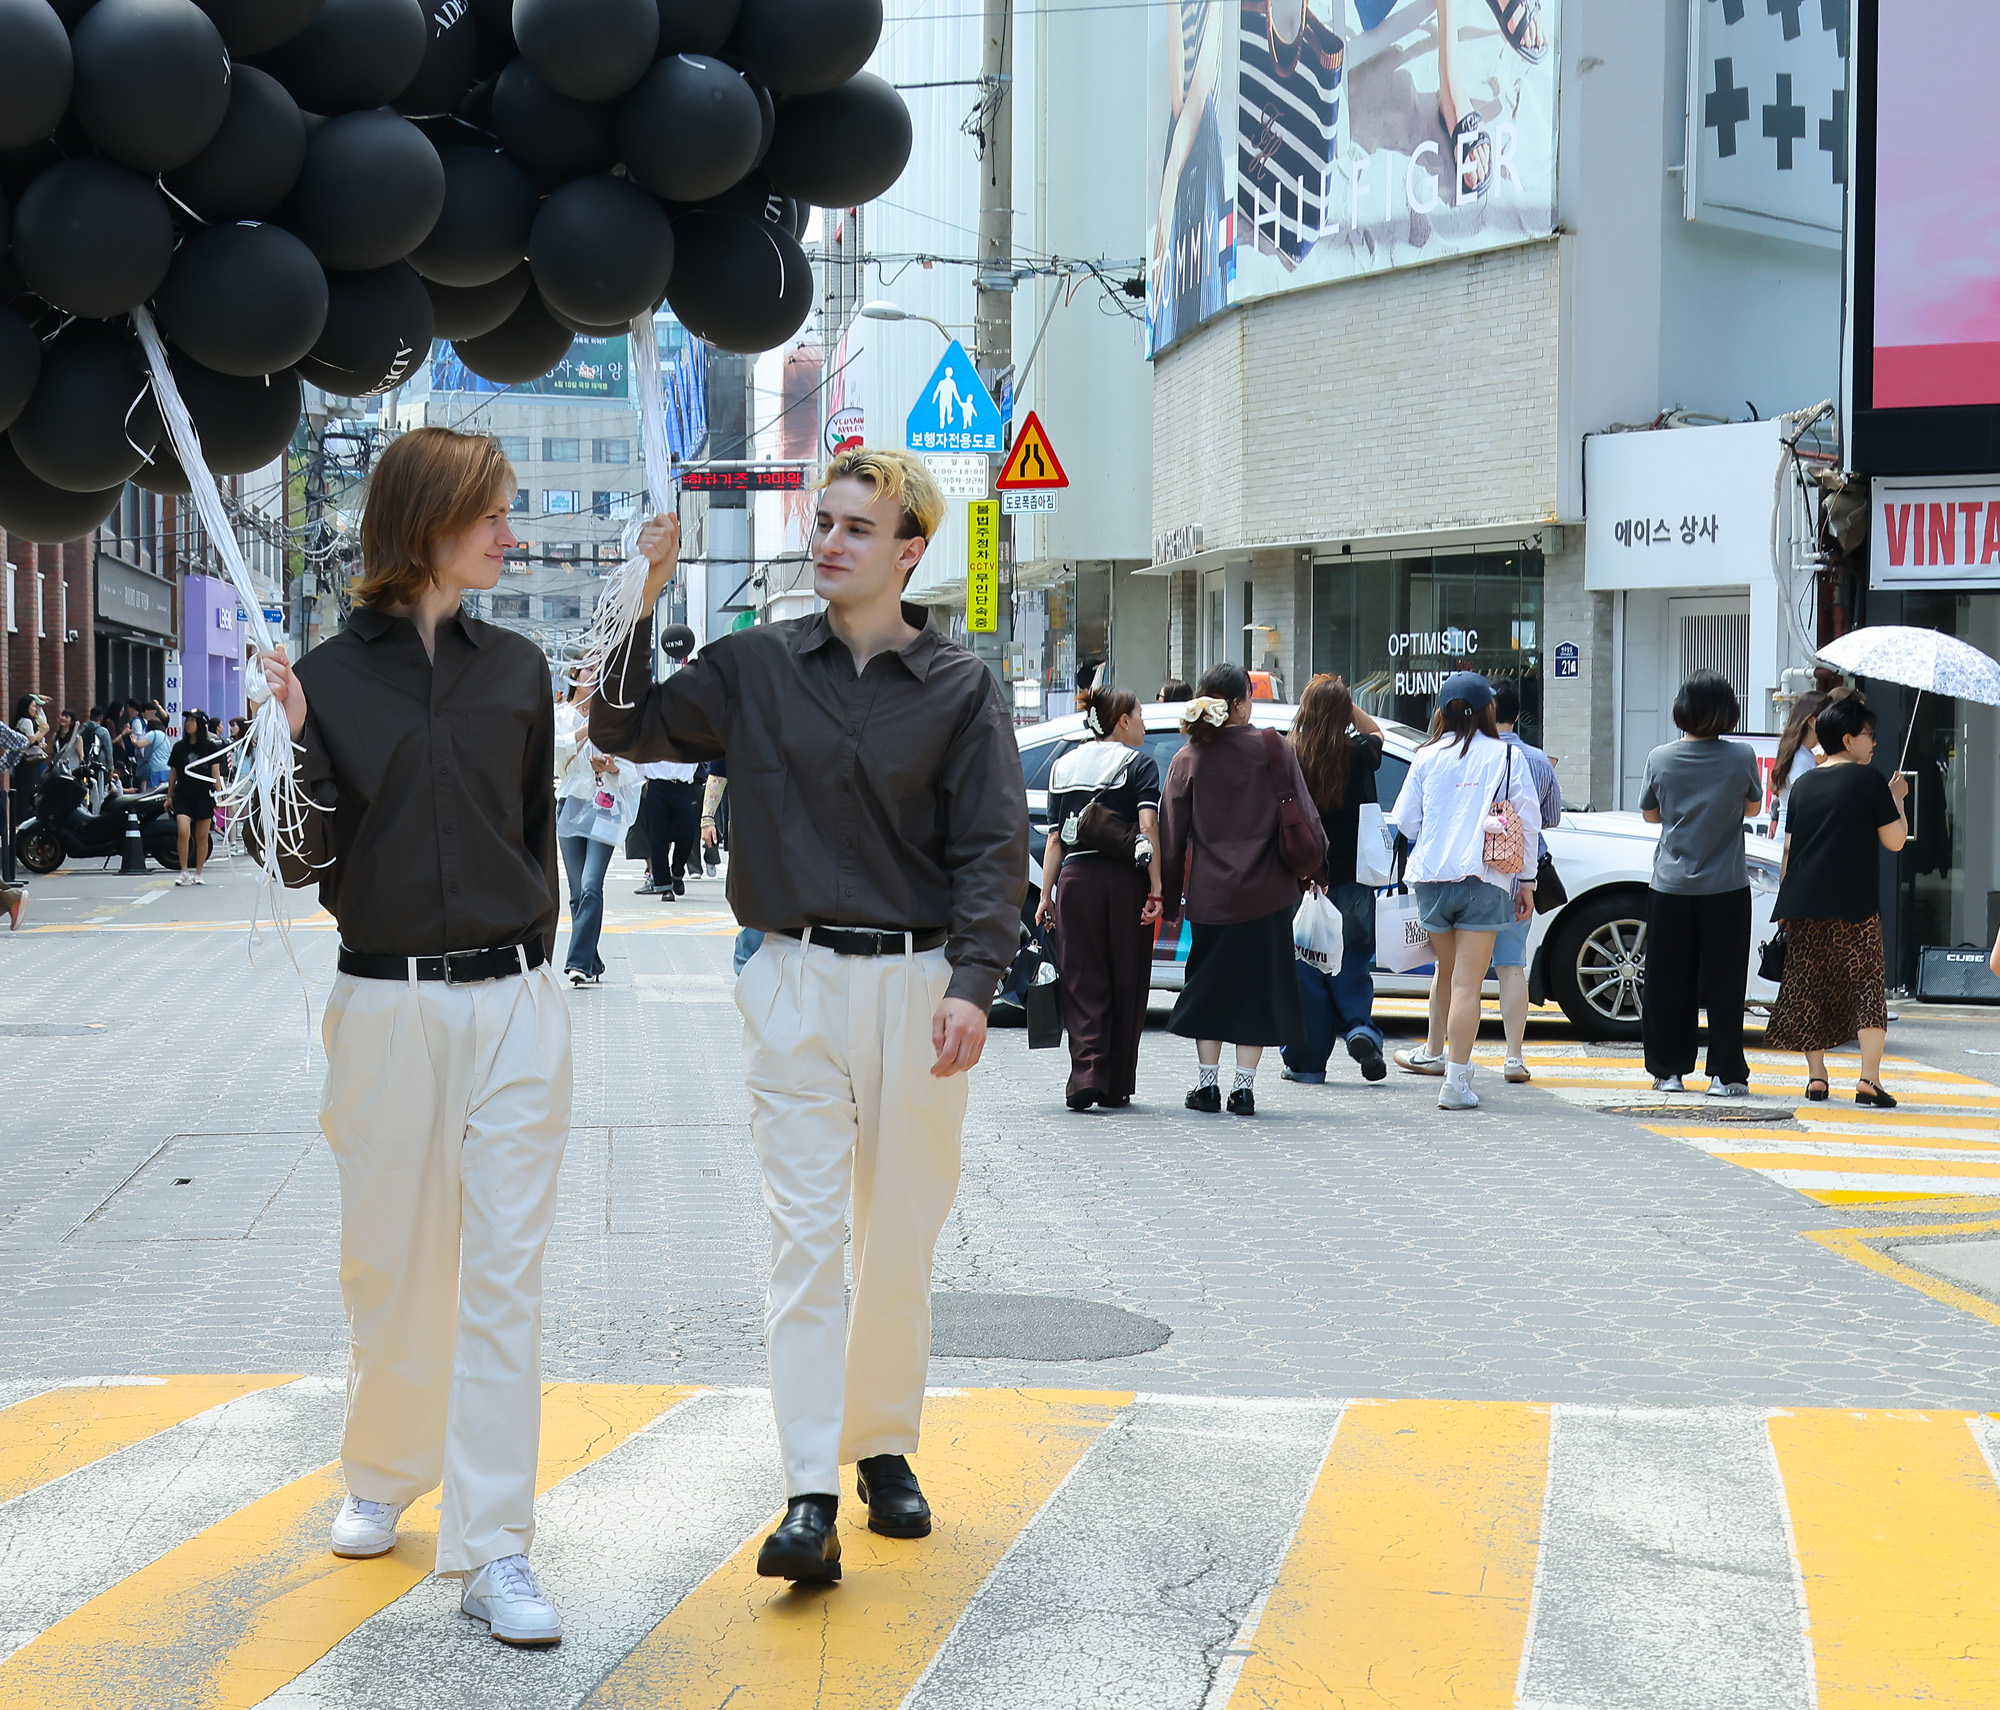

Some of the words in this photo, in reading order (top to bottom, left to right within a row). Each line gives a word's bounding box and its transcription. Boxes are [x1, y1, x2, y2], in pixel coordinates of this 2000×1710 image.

[1151, 210, 1215, 322] TOMMY
[1253, 121, 1525, 253] HILFIGER
[608, 362, 624, 381] 양
[911, 432, 996, 449] 보행자전용도로
[1006, 494, 1054, 510] 도로폭좁아짐
[976, 505, 989, 560] 불법주정차
[1614, 518, 1671, 548] 에이스
[1679, 514, 1719, 544] 상사
[1883, 500, 2000, 567] VINTA
[969, 563, 995, 571] CCTV
[975, 573, 989, 628] 무인단속중
[1388, 629, 1478, 656] OPTIMISTIC
